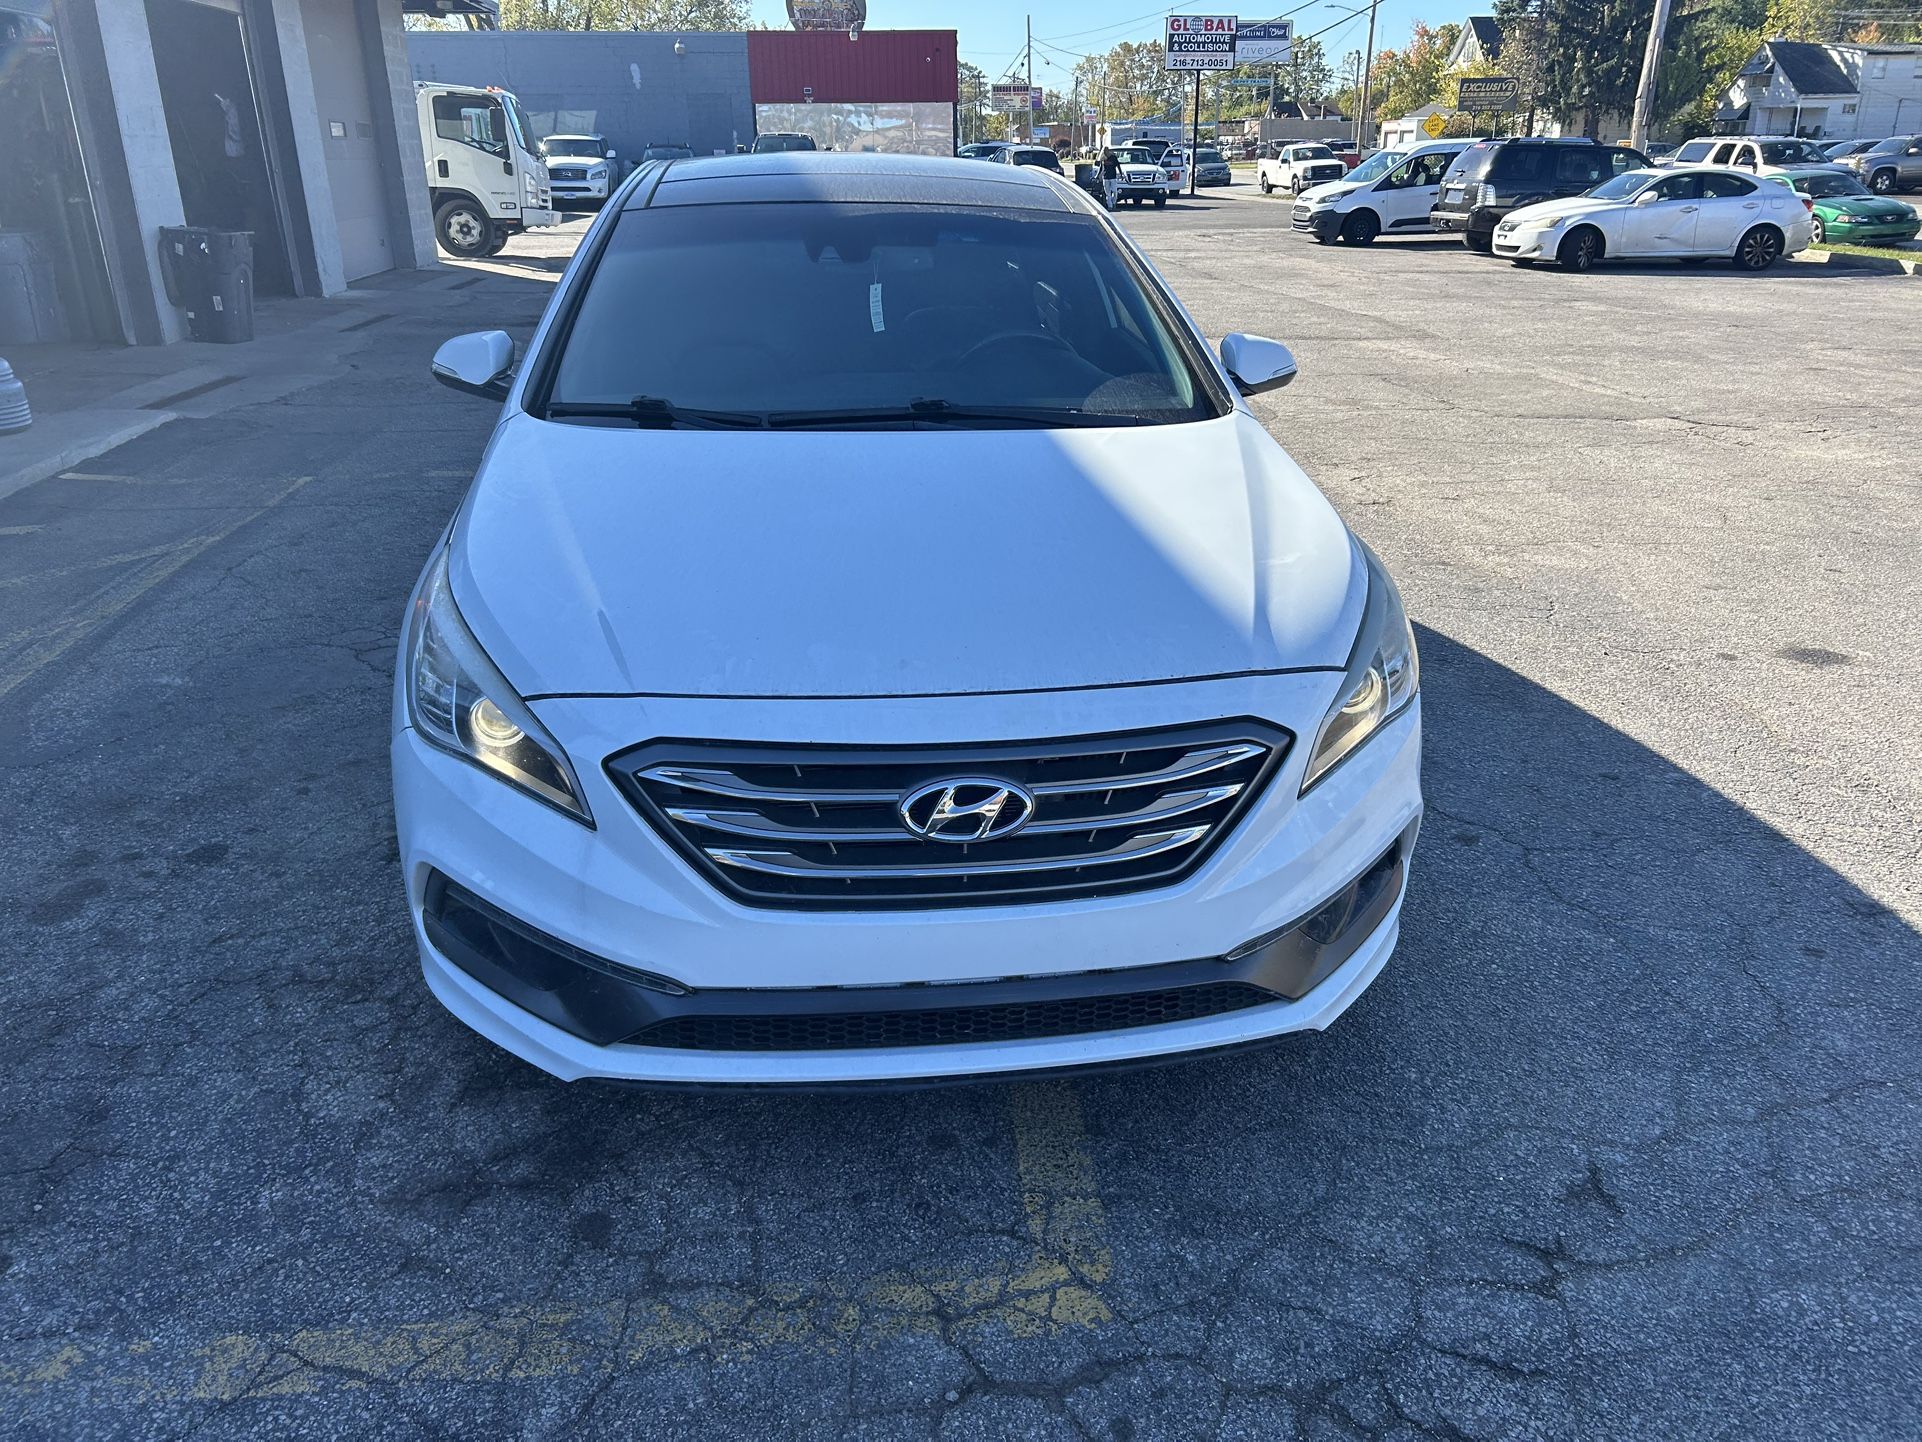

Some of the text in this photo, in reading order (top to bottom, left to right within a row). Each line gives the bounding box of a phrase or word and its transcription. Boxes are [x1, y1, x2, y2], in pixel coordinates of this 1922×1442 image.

[1170, 17, 1234, 32] GLOBAL
[1172, 34, 1231, 43] AUTOMOTIVE
[1173, 43, 1230, 51] & COLLISION
[1172, 58, 1229, 67] 216-713-0051
[1461, 82, 1515, 92] EXCLUSIVE
